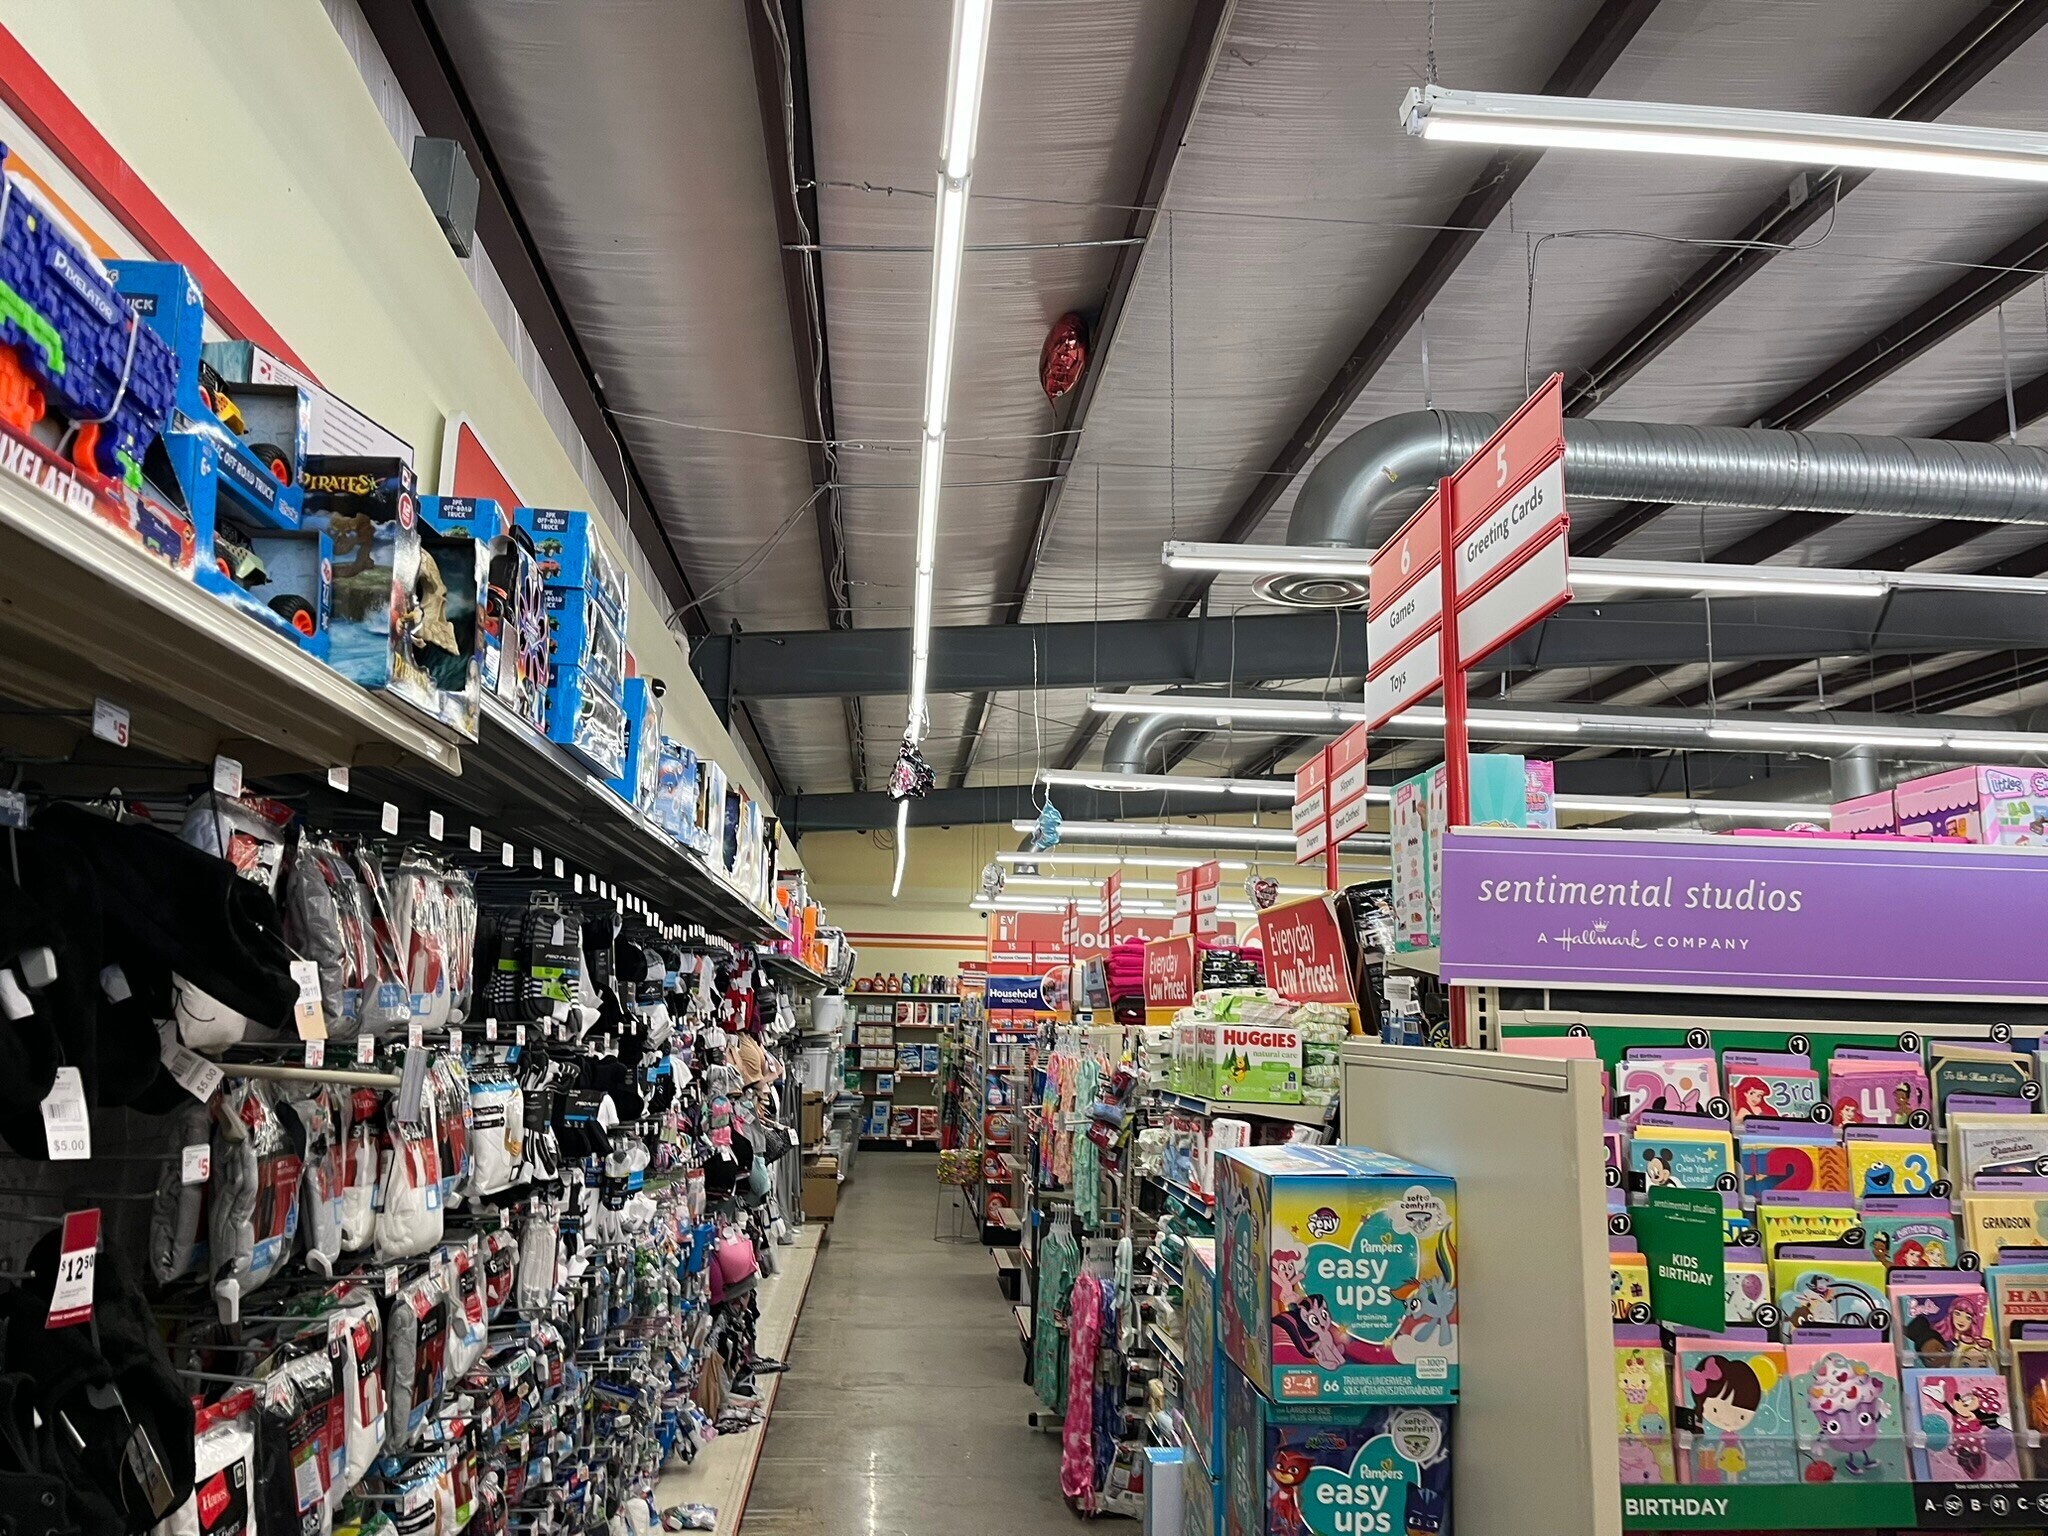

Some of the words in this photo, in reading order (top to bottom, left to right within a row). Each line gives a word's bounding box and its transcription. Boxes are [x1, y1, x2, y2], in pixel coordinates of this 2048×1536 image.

[54, 250, 114, 321] PIXELATOR
[1495, 443, 1507, 488] 5
[223, 452, 238, 471] OFF
[235, 460, 256, 485] ROAD
[254, 472, 276, 503] TRUCK
[540, 523, 559, 531] TRUCK
[1466, 515, 1510, 564] Greeting
[1510, 486, 1544, 527] Cards
[1400, 538, 1411, 575] 6
[1389, 597, 1416, 629] Games
[1389, 671, 1407, 694] Toys
[1309, 766, 1315, 785] 8
[1478, 874, 1673, 910] sentimental
[1684, 878, 1803, 913] studios
[1007, 942, 1017, 951] 15
[1051, 943, 1060, 951] 16
[1270, 911, 1316, 961] Everyday
[1537, 932, 1548, 945] A
[1554, 926, 1649, 952] Hallmark
[1654, 936, 1750, 951] COMPANY
[1149, 947, 1179, 979] Everyday
[1149, 977, 1164, 1001] Low
[1164, 974, 1188, 1000] Prices!
[1274, 963, 1296, 995] Low
[1296, 961, 1339, 994] Prices!
[989, 988, 1038, 999] Household
[1223, 1029, 1297, 1048] HUGGIES
[1252, 1050, 1281, 1059] natural
[196, 1068, 218, 1095] $5.00
[1943, 1070, 1955, 1080] To
[1624, 1070, 1665, 1123] 2
[1772, 1081, 1814, 1106] 3rd
[1861, 1087, 1892, 1124] 4
[53, 1139, 85, 1152] $5.00
[1990, 1143, 2034, 1159] Grandson
[1676, 1163, 1693, 1173] One
[1694, 1164, 1713, 1174] Year
[1766, 1147, 1813, 1191] 2
[1903, 1153, 1934, 1194] 3
[1654, 1199, 1692, 1211] sentimental
[1692, 1204, 1716, 1215] studios
[1982, 1216, 2031, 1229] GRANDSON
[1360, 1238, 1403, 1255] Pampers
[1317, 1258, 1388, 1284] easy
[1672, 1253, 1698, 1269] KIDS
[1658, 1265, 1714, 1286] BIRTHDAY
[1336, 1284, 1393, 1311] ups
[1351, 1322, 1393, 1330] underwear
[1356, 1313, 1387, 1323] training
[1323, 1380, 1340, 1392] 66
[1343, 1376, 1372, 1386] TRAINING
[1372, 1376, 1412, 1386] UNDERWEAR
[1404, 1418, 1421, 1426] soft
[1360, 1464, 1404, 1481] Pampers
[1316, 1482, 1389, 1511] easy
[1625, 1498, 1730, 1517] BIRTHDAY
[1334, 1511, 1392, 1536] ups
